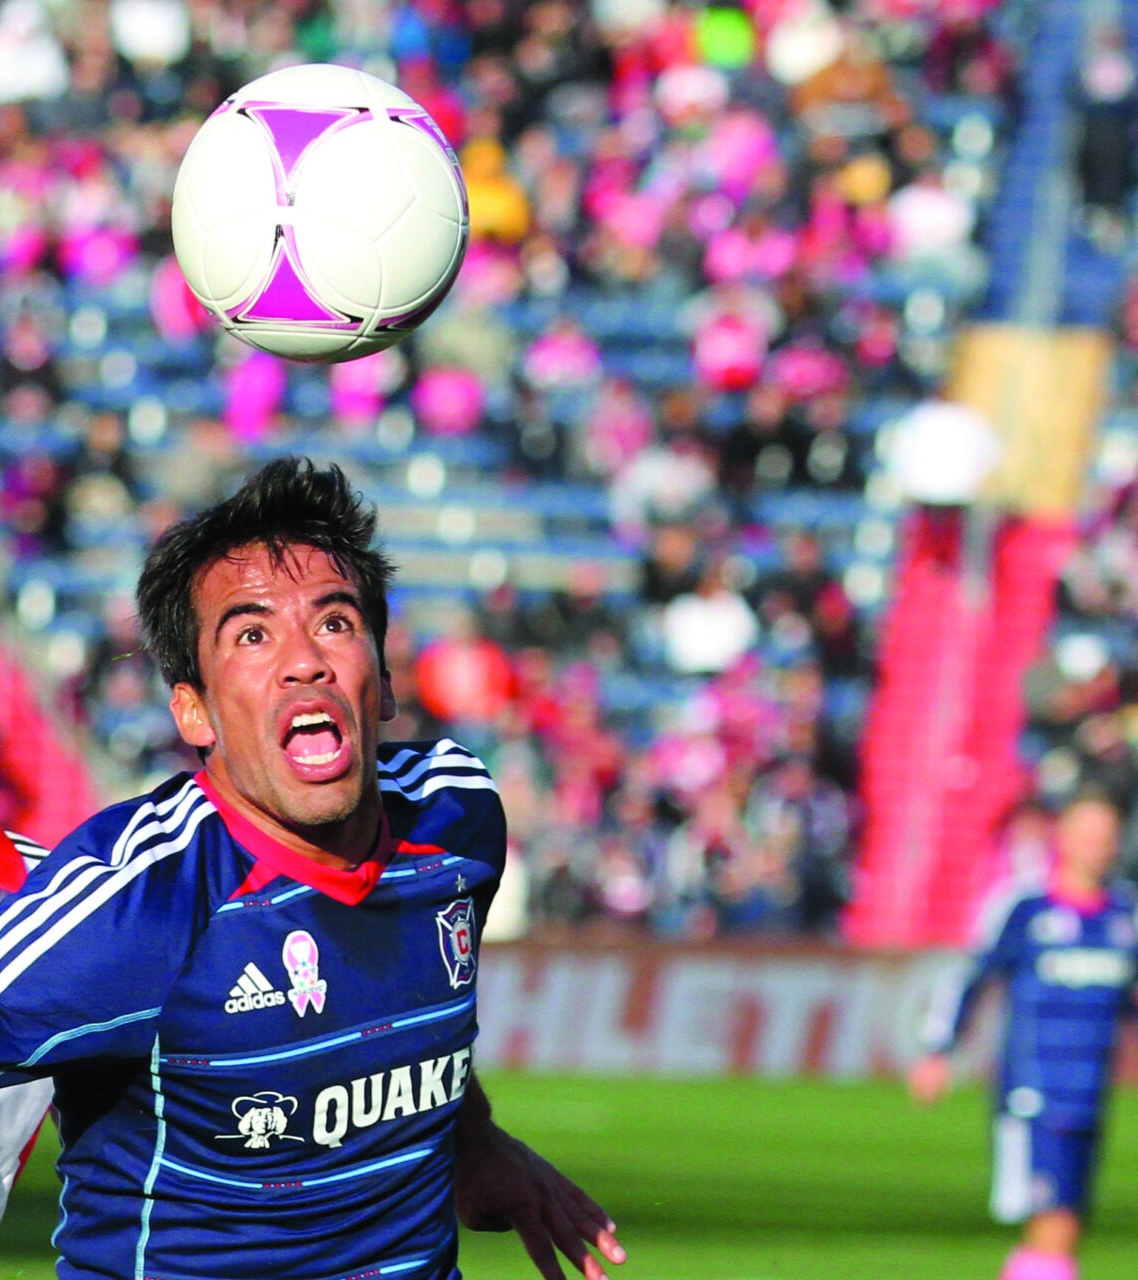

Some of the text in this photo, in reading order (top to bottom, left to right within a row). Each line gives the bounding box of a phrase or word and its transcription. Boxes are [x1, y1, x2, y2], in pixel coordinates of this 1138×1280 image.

[456, 927, 471, 956] C
[224, 989, 286, 1014] adidas
[313, 1045, 471, 1148] QUAKE
